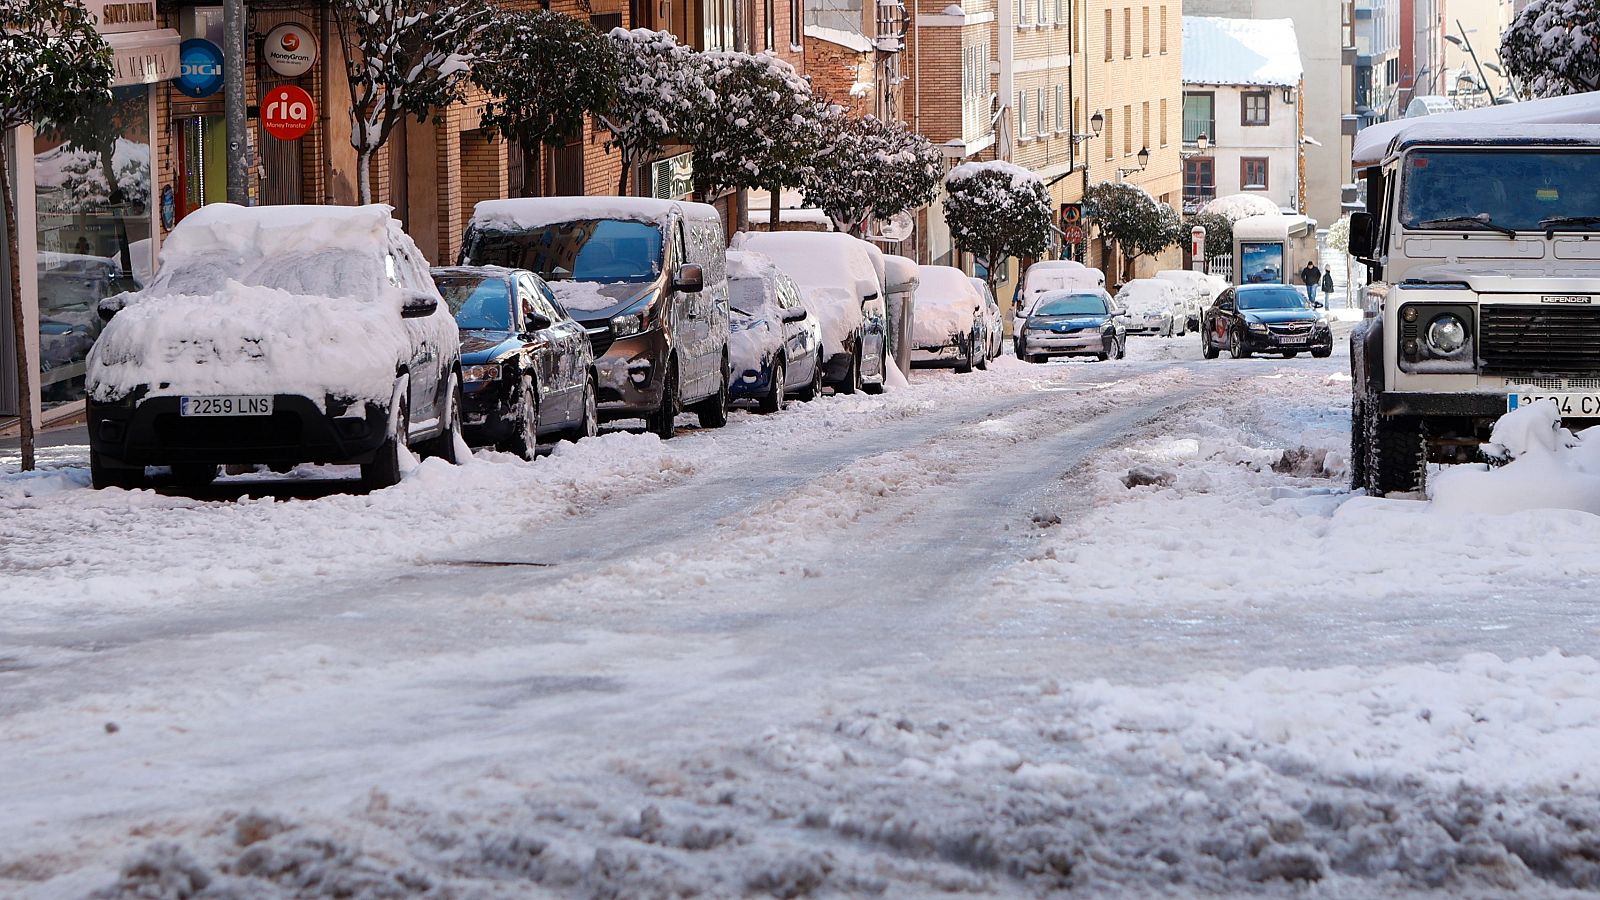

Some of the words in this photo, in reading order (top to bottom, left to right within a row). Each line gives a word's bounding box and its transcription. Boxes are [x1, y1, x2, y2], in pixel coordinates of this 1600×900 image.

[270, 52, 309, 61] MoneyGram
[129, 53, 166, 78] MARIA
[181, 64, 222, 76] DIGI
[266, 92, 307, 120] ria
[266, 121, 285, 129] Money
[1542, 296, 1589, 304] DEFENDER
[192, 399, 233, 414] 2259
[238, 398, 269, 414] LNS
